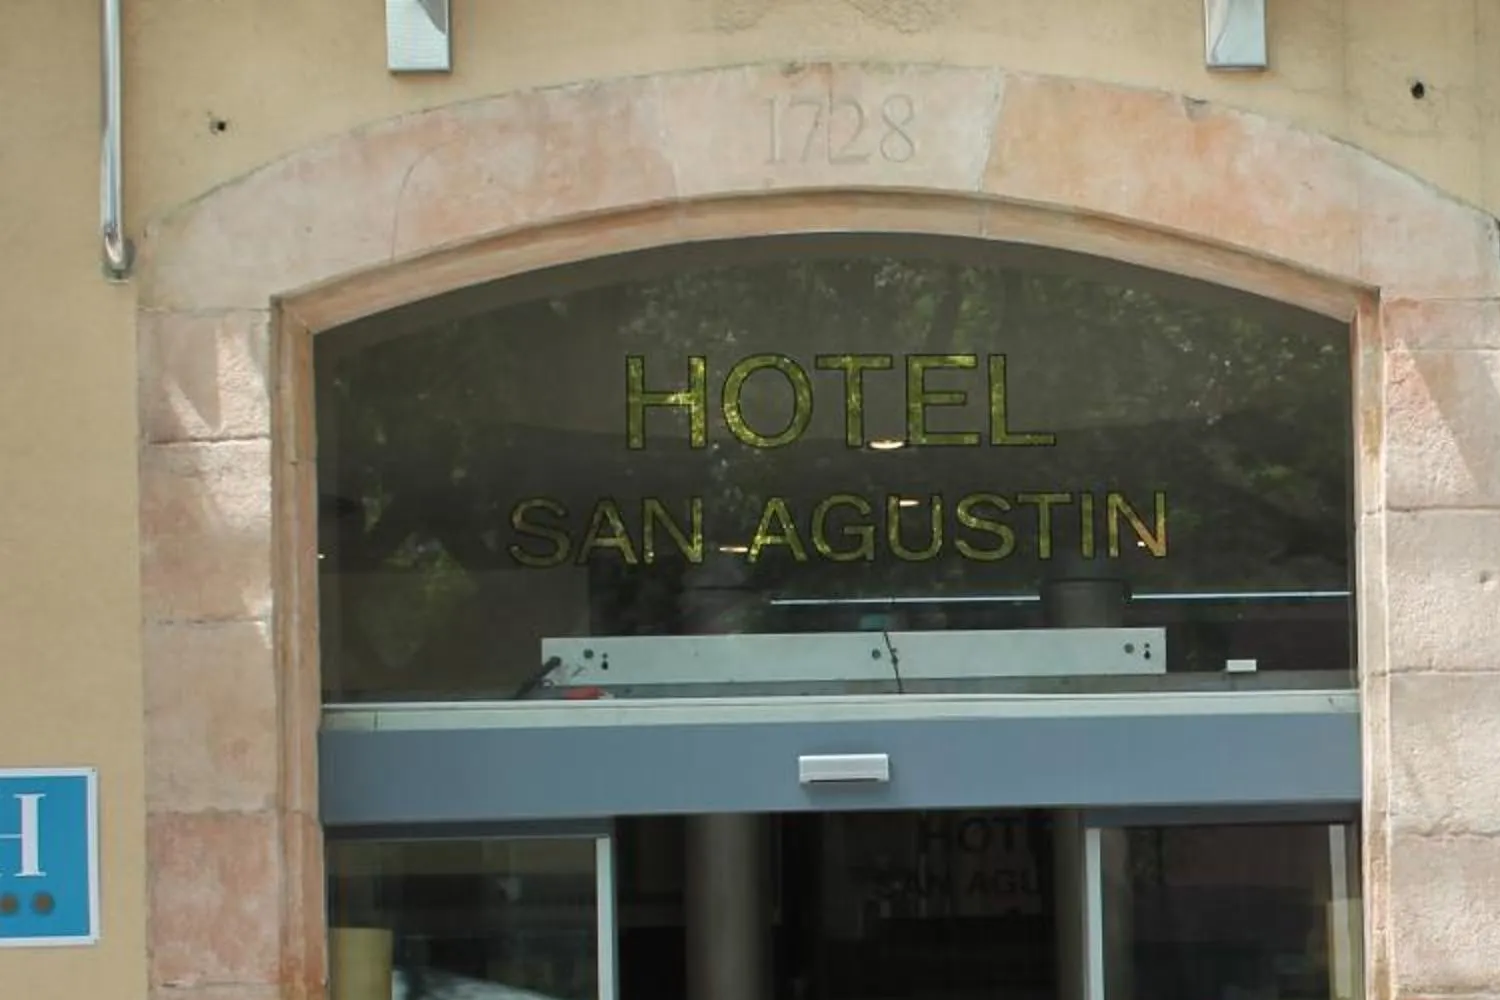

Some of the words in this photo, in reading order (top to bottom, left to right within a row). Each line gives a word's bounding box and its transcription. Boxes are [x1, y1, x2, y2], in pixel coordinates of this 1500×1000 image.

[764, 93, 915, 165] 1728
[625, 353, 1056, 450] HOTEL
[509, 497, 705, 567] SAN
[744, 490, 1167, 563] AGUSTIN
